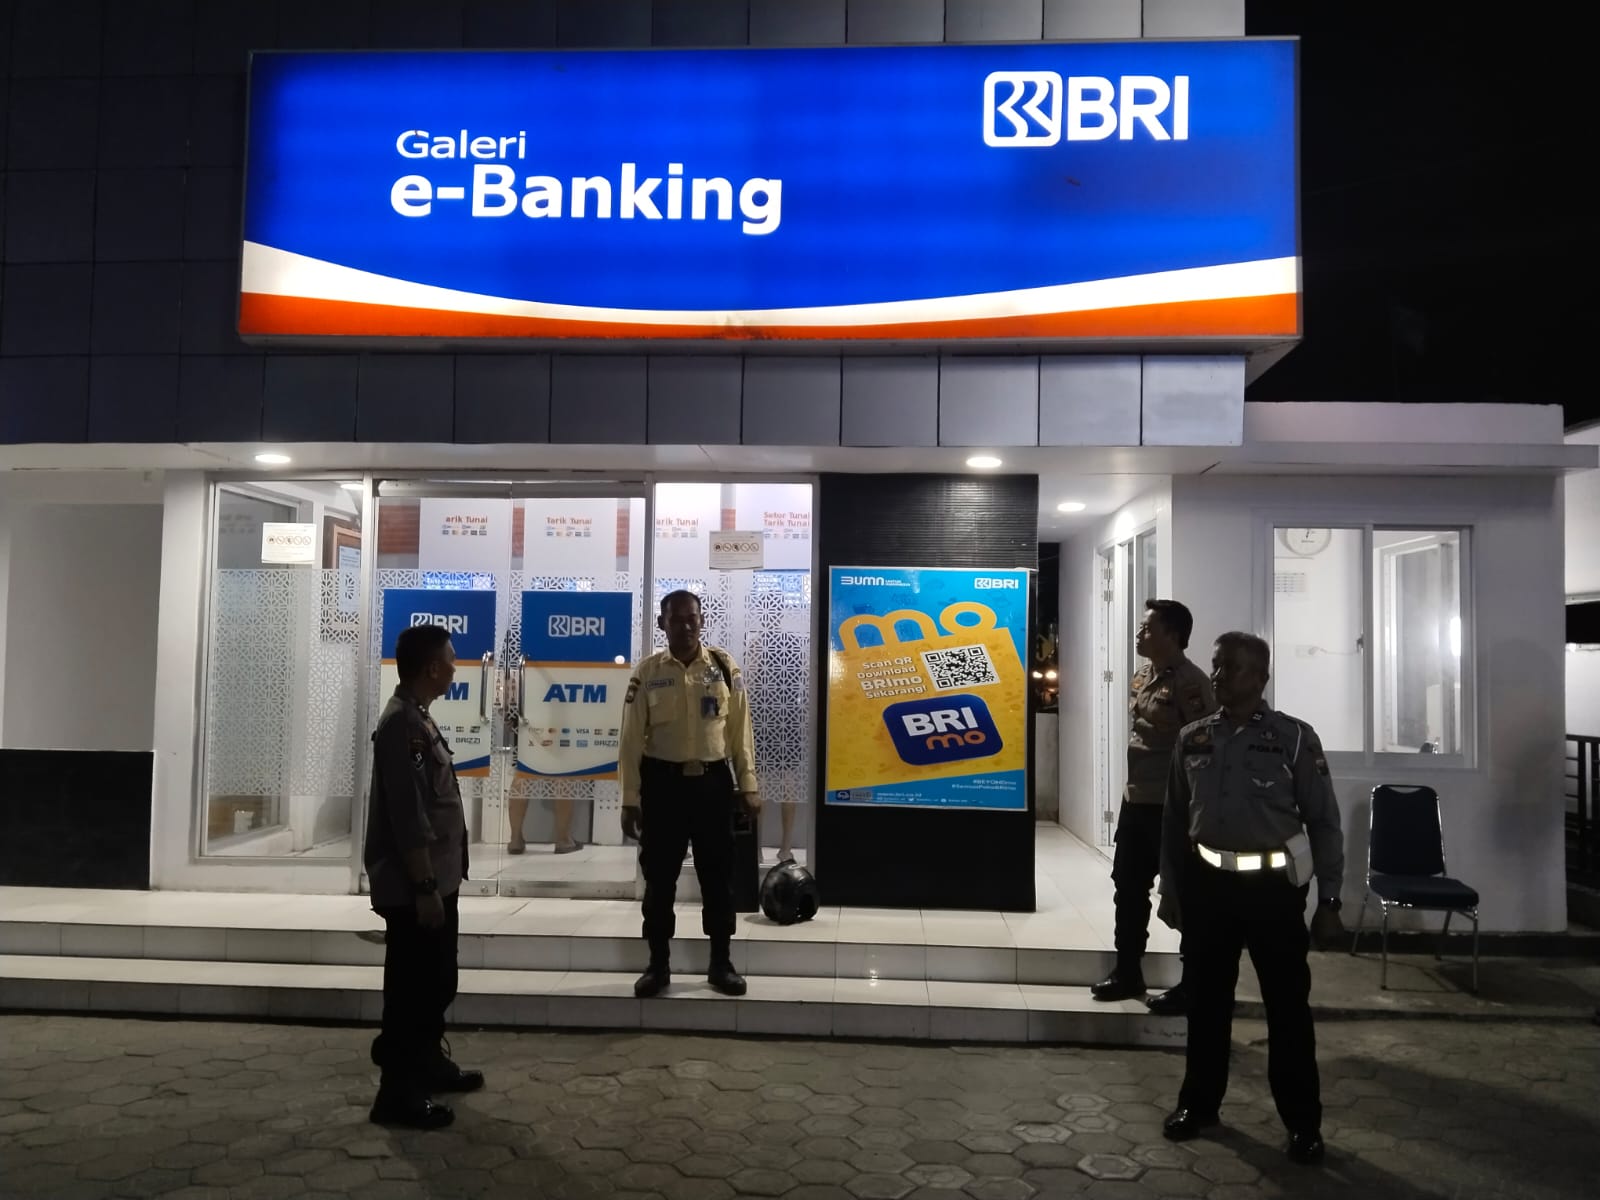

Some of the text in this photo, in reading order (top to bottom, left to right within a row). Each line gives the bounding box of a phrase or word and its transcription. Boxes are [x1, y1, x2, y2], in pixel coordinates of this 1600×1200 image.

[1067, 75, 1190, 141] BRI
[396, 129, 527, 160] Galeri
[390, 162, 783, 236] e-Banking
[465, 515, 488, 524] Tunai
[546, 516, 593, 526] Tarik Tunai
[655, 517, 699, 527] arik Tunai
[991, 578, 1019, 589] BRI
[571, 616, 605, 637] BRI
[862, 655, 913, 670] Scan QR
[856, 665, 917, 679] Download
[860, 675, 923, 691] BRImo
[543, 683, 608, 703] ATM
[865, 684, 928, 699] Sekarang!
[901, 706, 980, 737] BRI
[925, 729, 987, 751] mo
